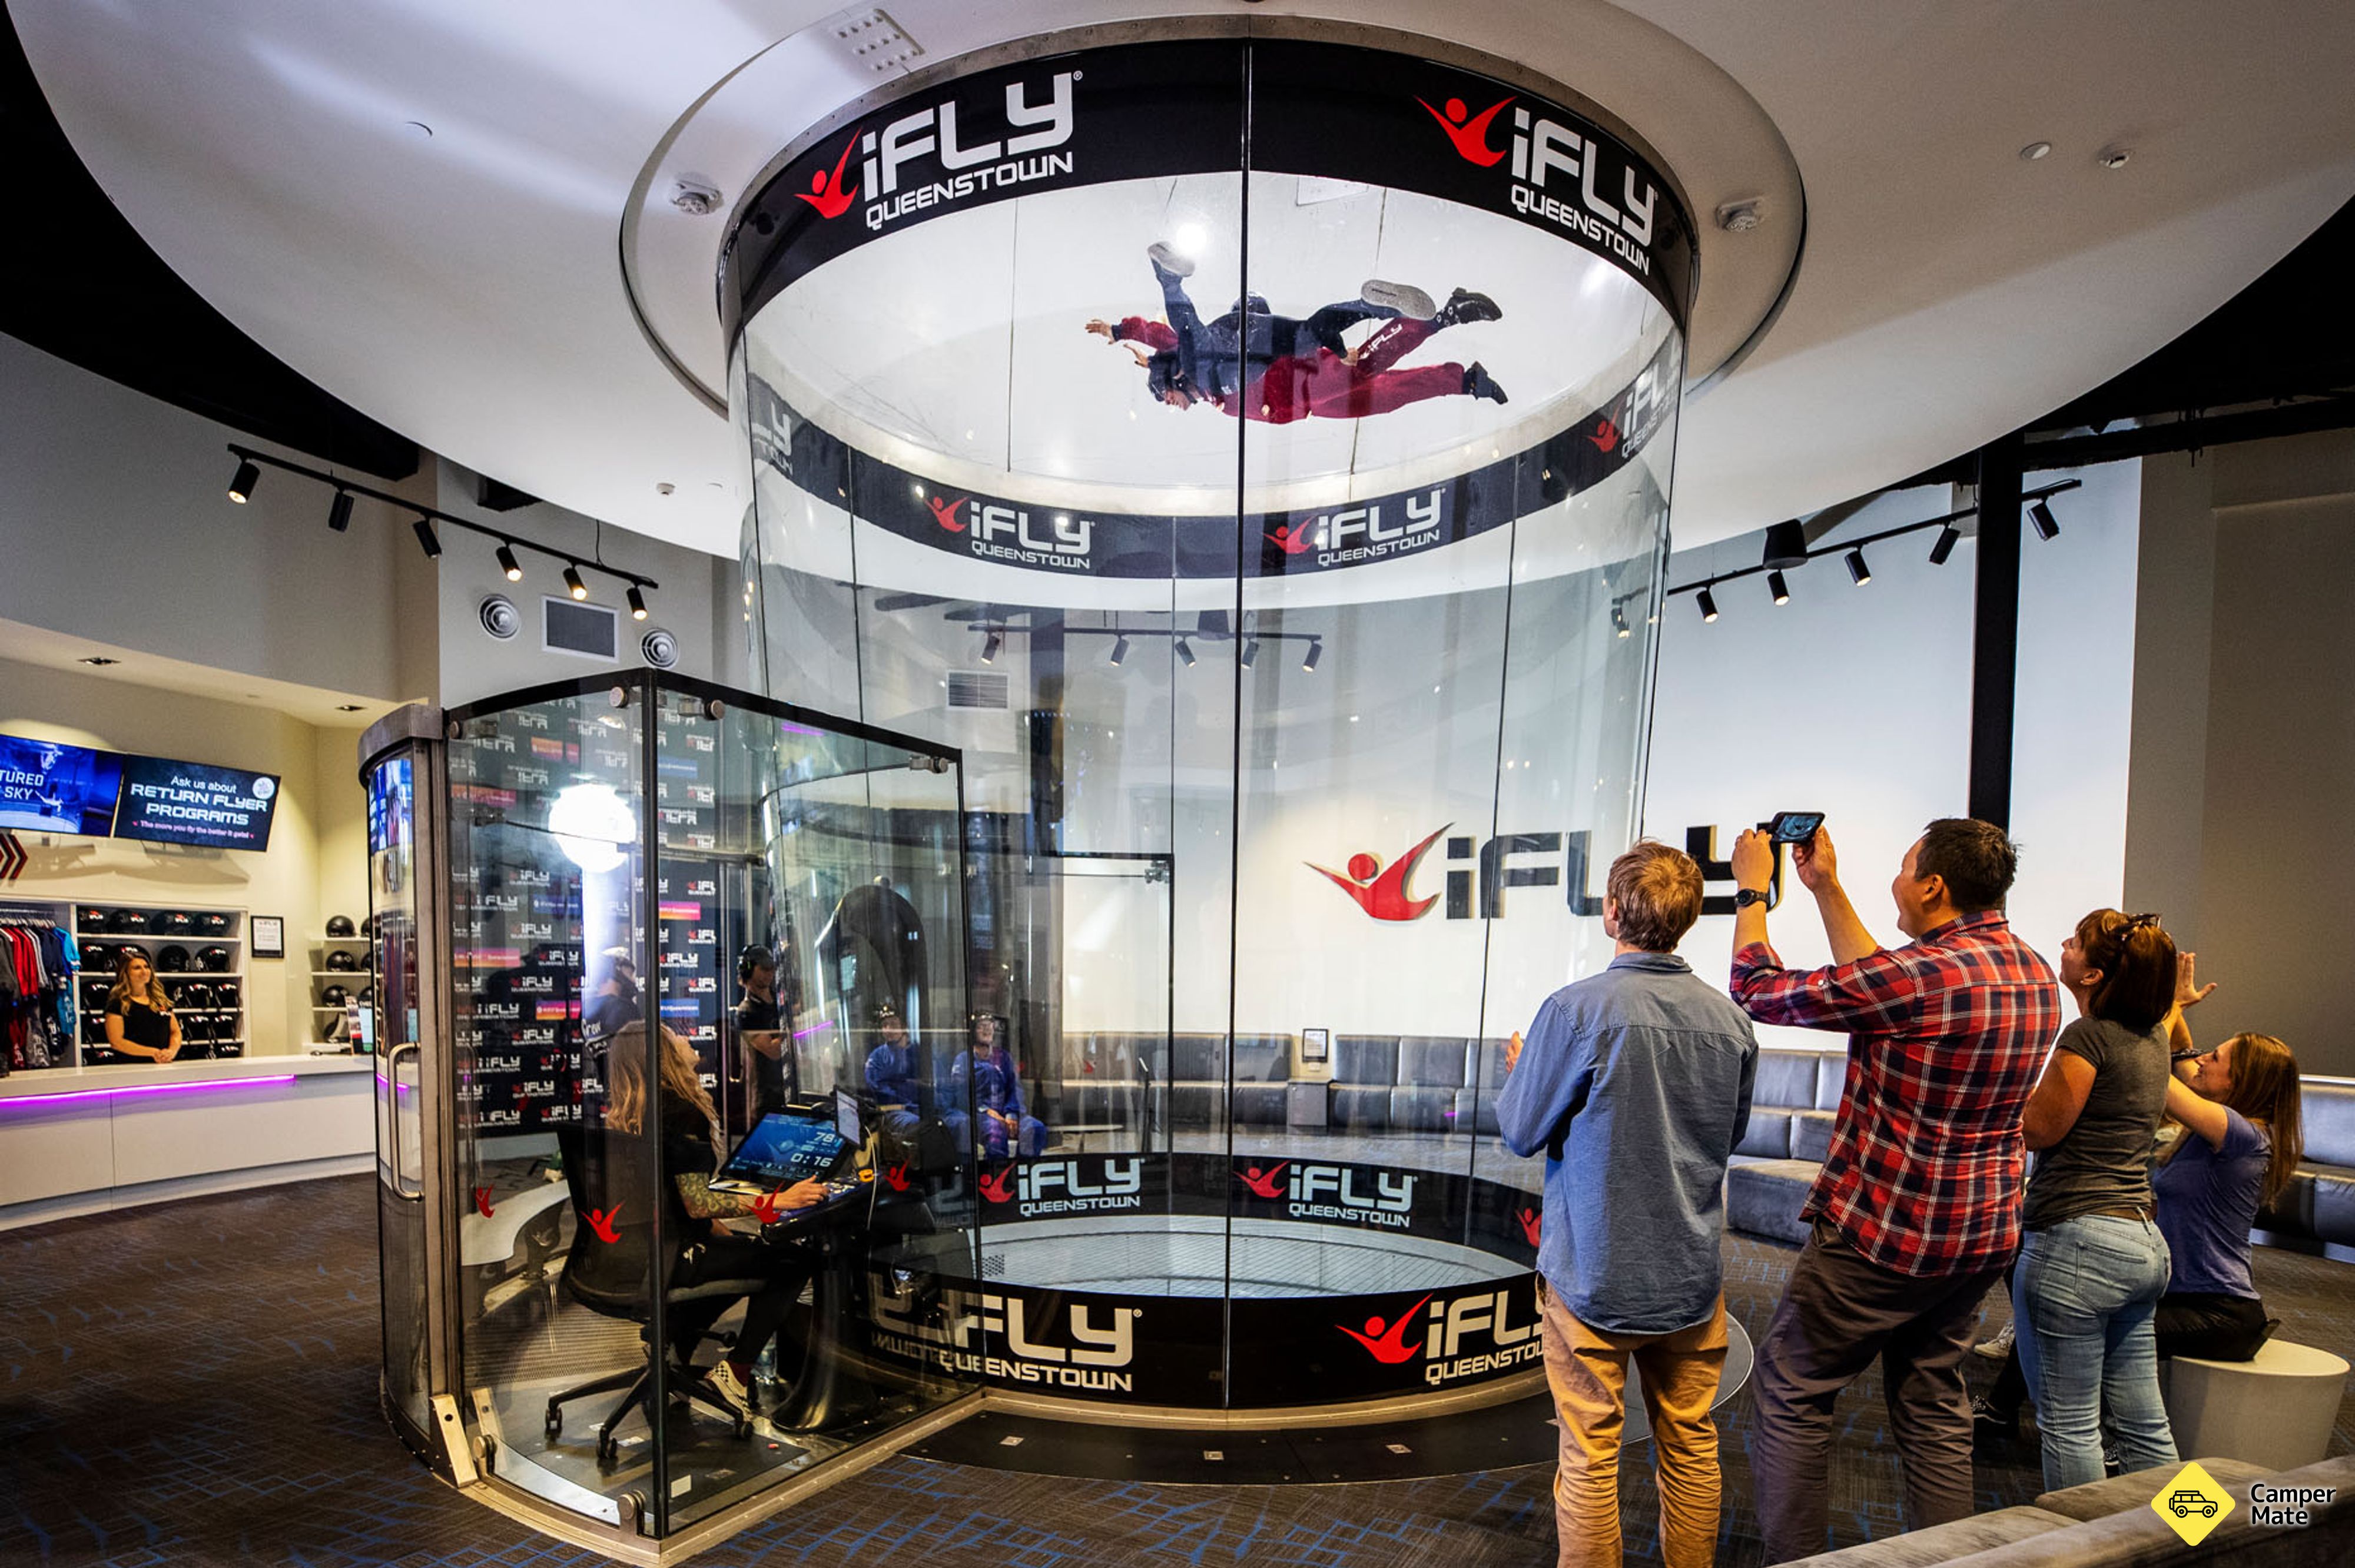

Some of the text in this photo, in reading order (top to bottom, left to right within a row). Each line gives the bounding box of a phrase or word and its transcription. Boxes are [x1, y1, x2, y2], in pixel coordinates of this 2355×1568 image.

[865, 151, 1073, 231] QUEENSTOWN
[1511, 184, 1650, 276] QUEENSTOWN
[971, 539, 1091, 570] QUEENSTOWN
[1318, 529, 1440, 567] QUEENSTOWN
[5, 786, 34, 800] SKY
[130, 783, 267, 812] RETURN FLYER
[171, 775, 237, 793] Ask us about
[146, 802, 249, 825] PROGRAMS
[791, 1153, 834, 1168] 0:16
[1020, 1195, 1140, 1217] QUEENSTOWN
[1289, 1202, 1409, 1228] QUEENSTOWN
[949, 1290, 1133, 1367] FLY
[1425, 1340, 1543, 1386] QUEENSTO
